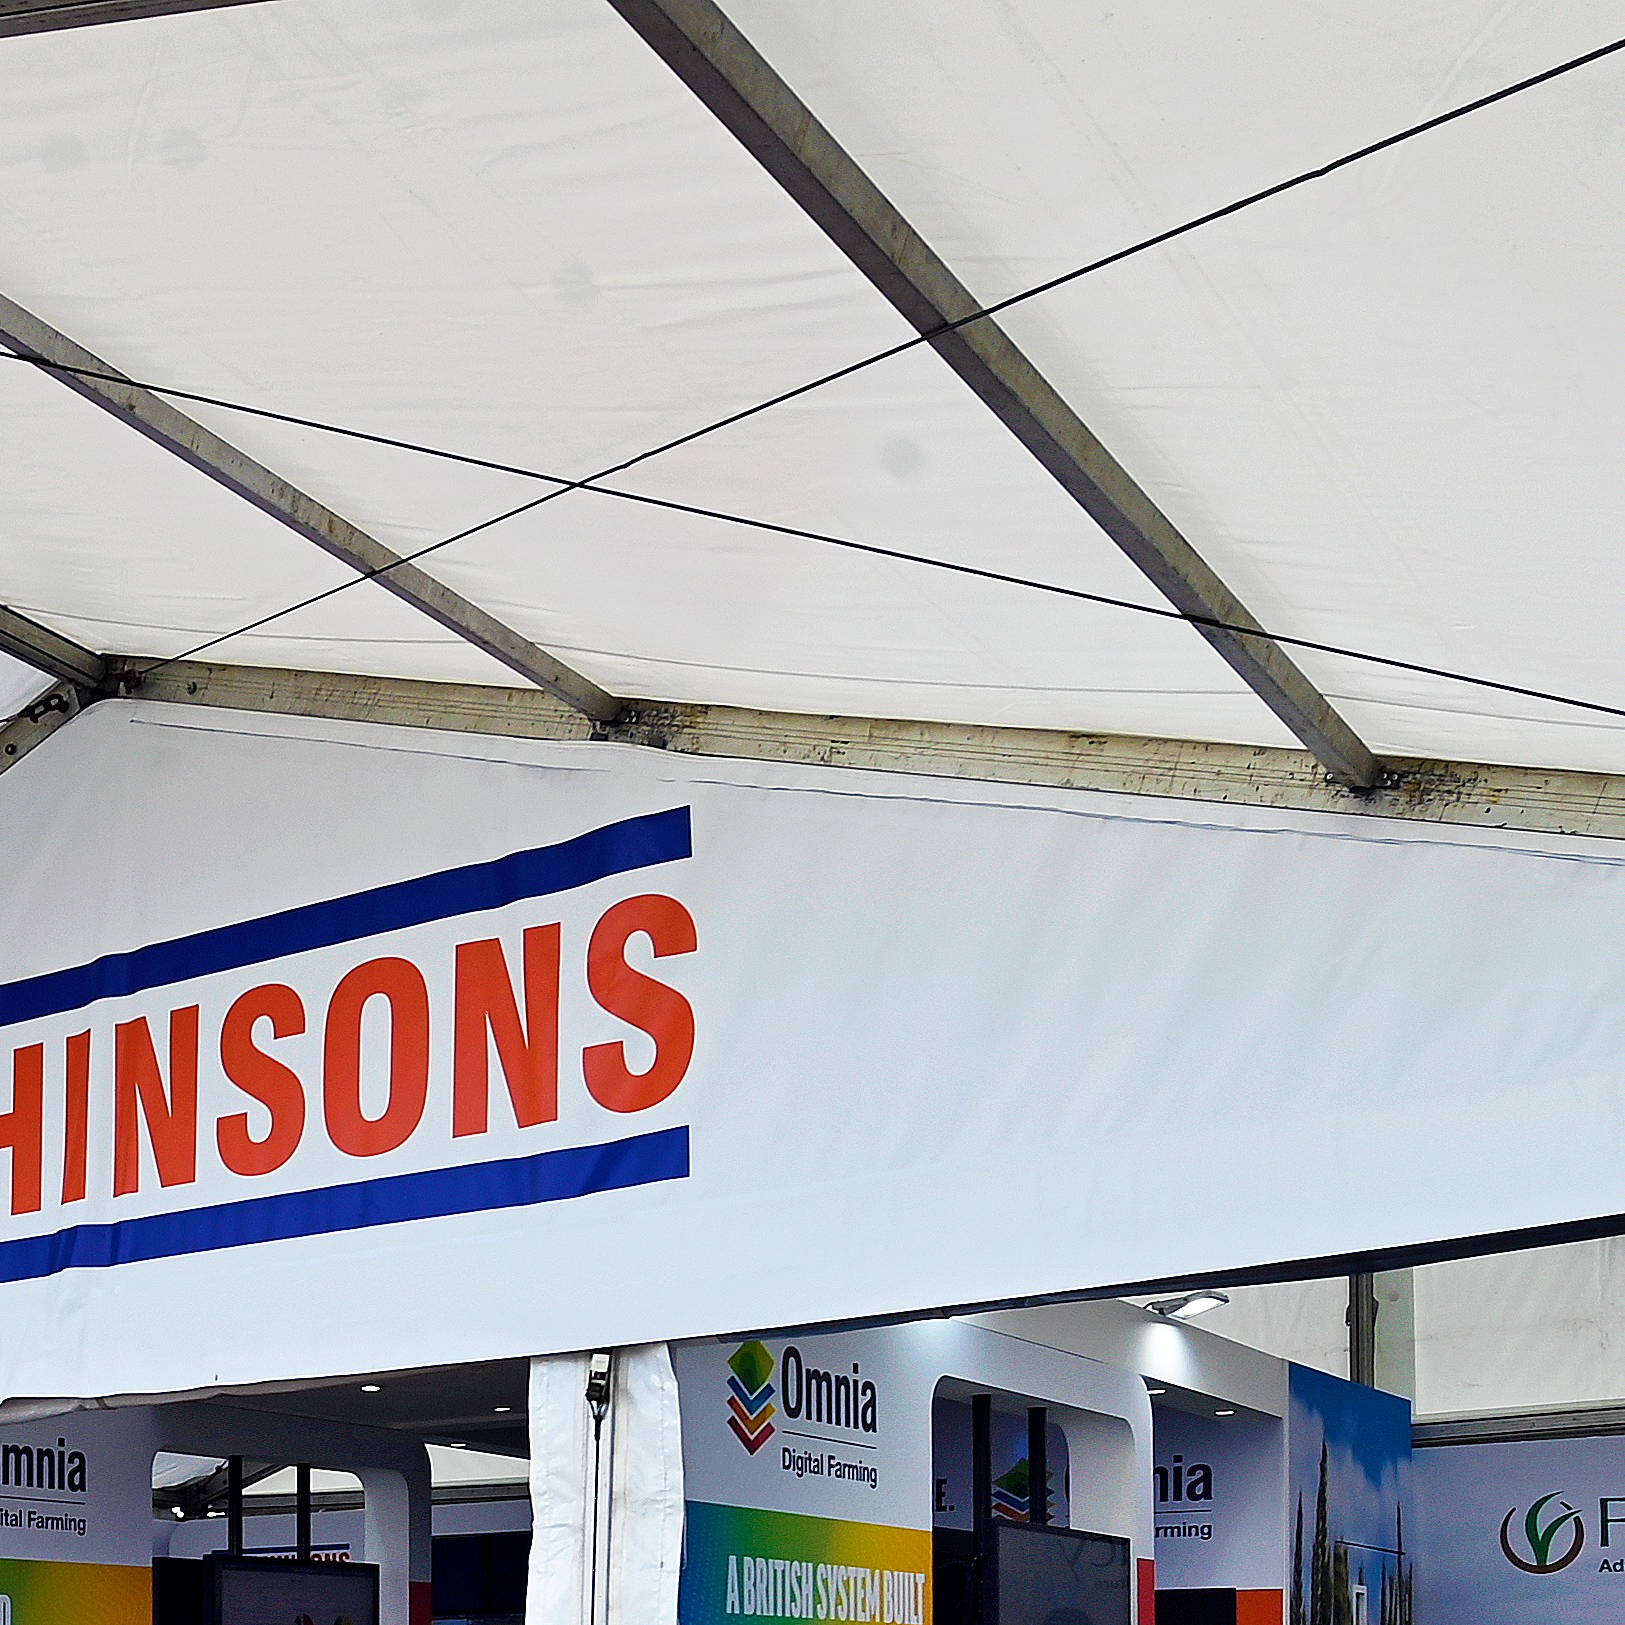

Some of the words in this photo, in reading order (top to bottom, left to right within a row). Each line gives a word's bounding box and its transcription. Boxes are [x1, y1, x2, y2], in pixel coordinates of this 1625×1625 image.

[782, 1346, 877, 1433] Omnia
[781, 1447, 823, 1477] Digital
[828, 1455, 877, 1488] Farming
[28, 1511, 86, 1536] Farming
[726, 1555, 740, 1614] A
[744, 1557, 813, 1618] BRITISH
[817, 1564, 881, 1622] SYSTEM
[884, 1571, 925, 1625] BUILT
